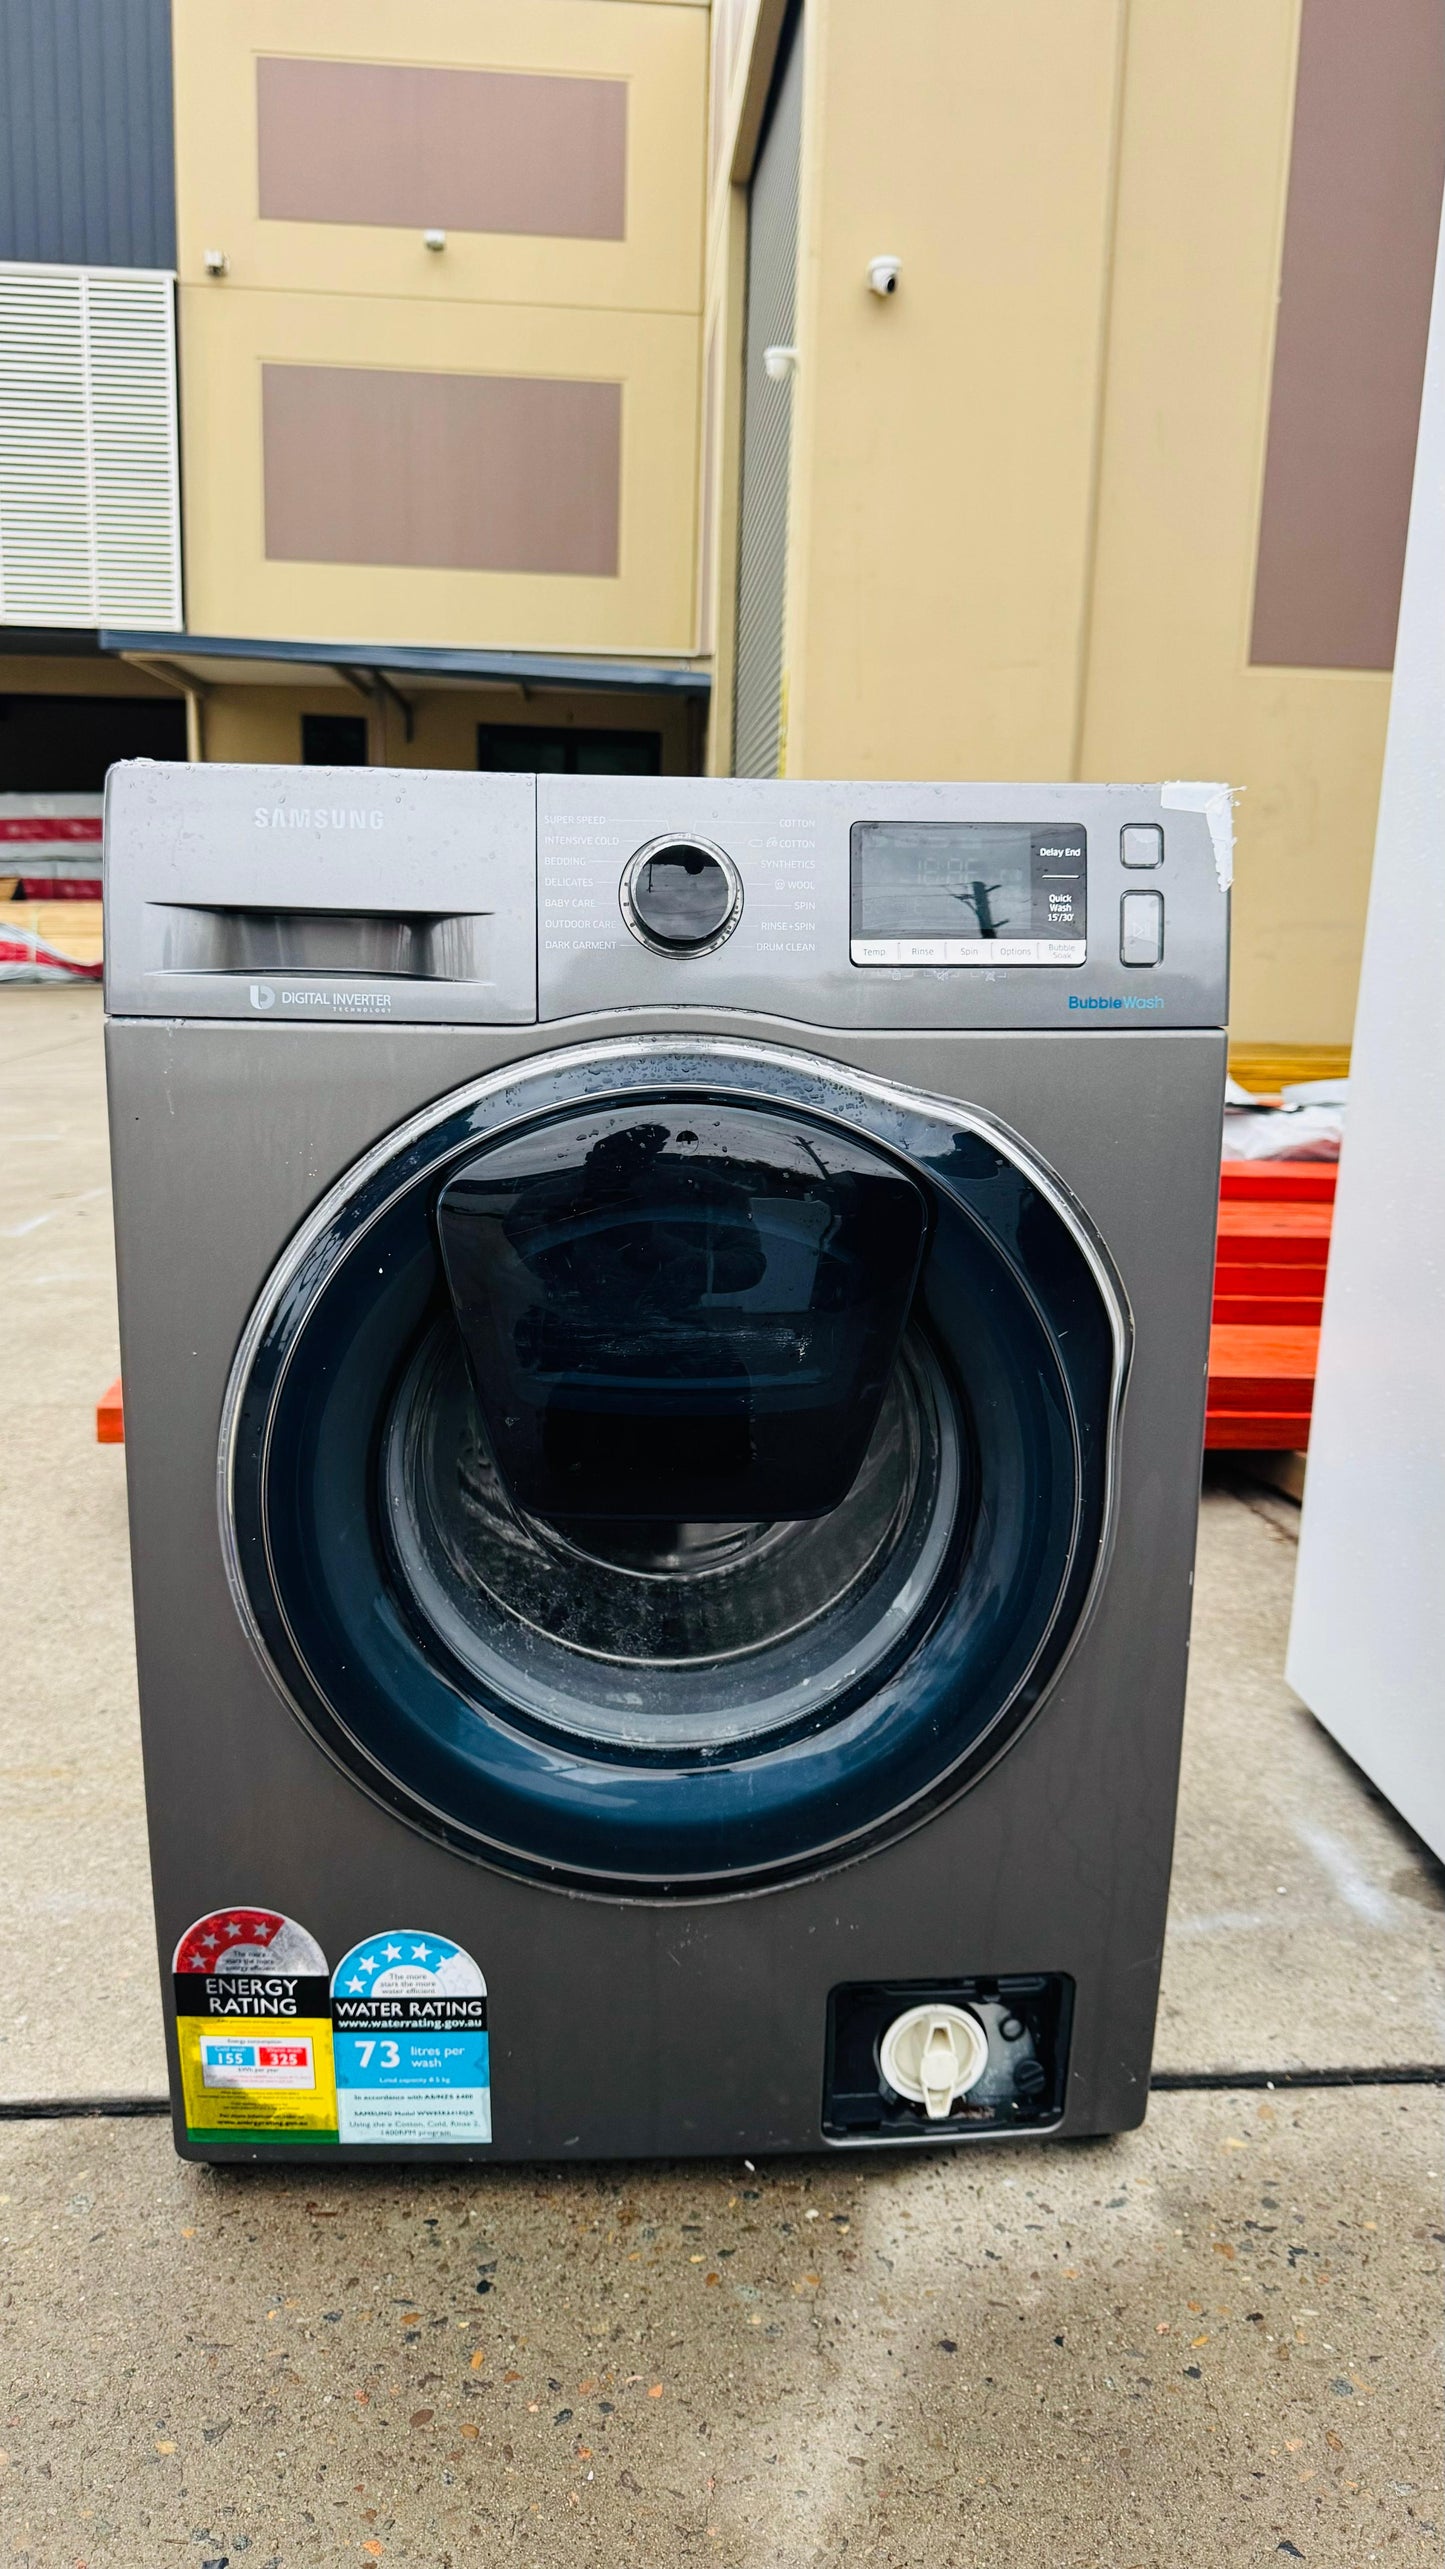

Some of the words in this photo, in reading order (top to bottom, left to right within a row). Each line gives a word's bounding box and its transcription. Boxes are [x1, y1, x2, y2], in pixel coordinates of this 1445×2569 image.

[255, 807, 384, 829] SAMSUNG
[544, 815, 575, 825] SUPER
[576, 815, 606, 825] SPEED
[779, 818, 816, 828] COTTON
[544, 836, 593, 846] INTENSIVE
[594, 836, 620, 846] COLD
[779, 839, 816, 849] COTTON
[1040, 847, 1064, 858] Delay
[1065, 847, 1081, 857] End
[544, 856, 586, 866] BEDDING
[760, 860, 816, 869] SYNTHETICS
[544, 877, 594, 887] DELICATES
[788, 880, 815, 890] WOOL
[545, 898, 569, 908] BABY
[572, 898, 595, 908] CARE
[1048, 893, 1072, 904] Quick
[793, 901, 816, 911] SPIN
[1049, 903, 1072, 913] Wash
[545, 919, 591, 929] OUTDOOR
[592, 919, 617, 929] CARE
[545, 940, 570, 950] DARK
[572, 940, 617, 950] GARMENT
[756, 942, 784, 952] DRUM
[785, 942, 816, 952] CLEAN
[1048, 943, 1076, 952] Bubble
[863, 947, 886, 957] Temp
[911, 947, 934, 956] Rinse
[960, 947, 979, 957] Spin
[1000, 947, 1032, 957] Options
[1052, 951, 1072, 960] Soak
[281, 991, 330, 1005] DIGITAL
[333, 992, 392, 1006] INVERTER
[1068, 995, 1164, 1009] BubbleWash
[205, 1978, 298, 1996] ENERGY
[209, 1997, 297, 2015] RATING
[335, 2002, 404, 2017] WATER
[409, 2001, 483, 2016] RATING
[338, 2018, 483, 2030] www.waterrating.gov.au
[354, 2040, 401, 2069] 73
[410, 2046, 441, 2057] litres
[444, 2047, 465, 2059] per
[217, 2053, 243, 2064] 155
[270, 2053, 298, 2065] 325
[411, 2058, 442, 2068] wash
